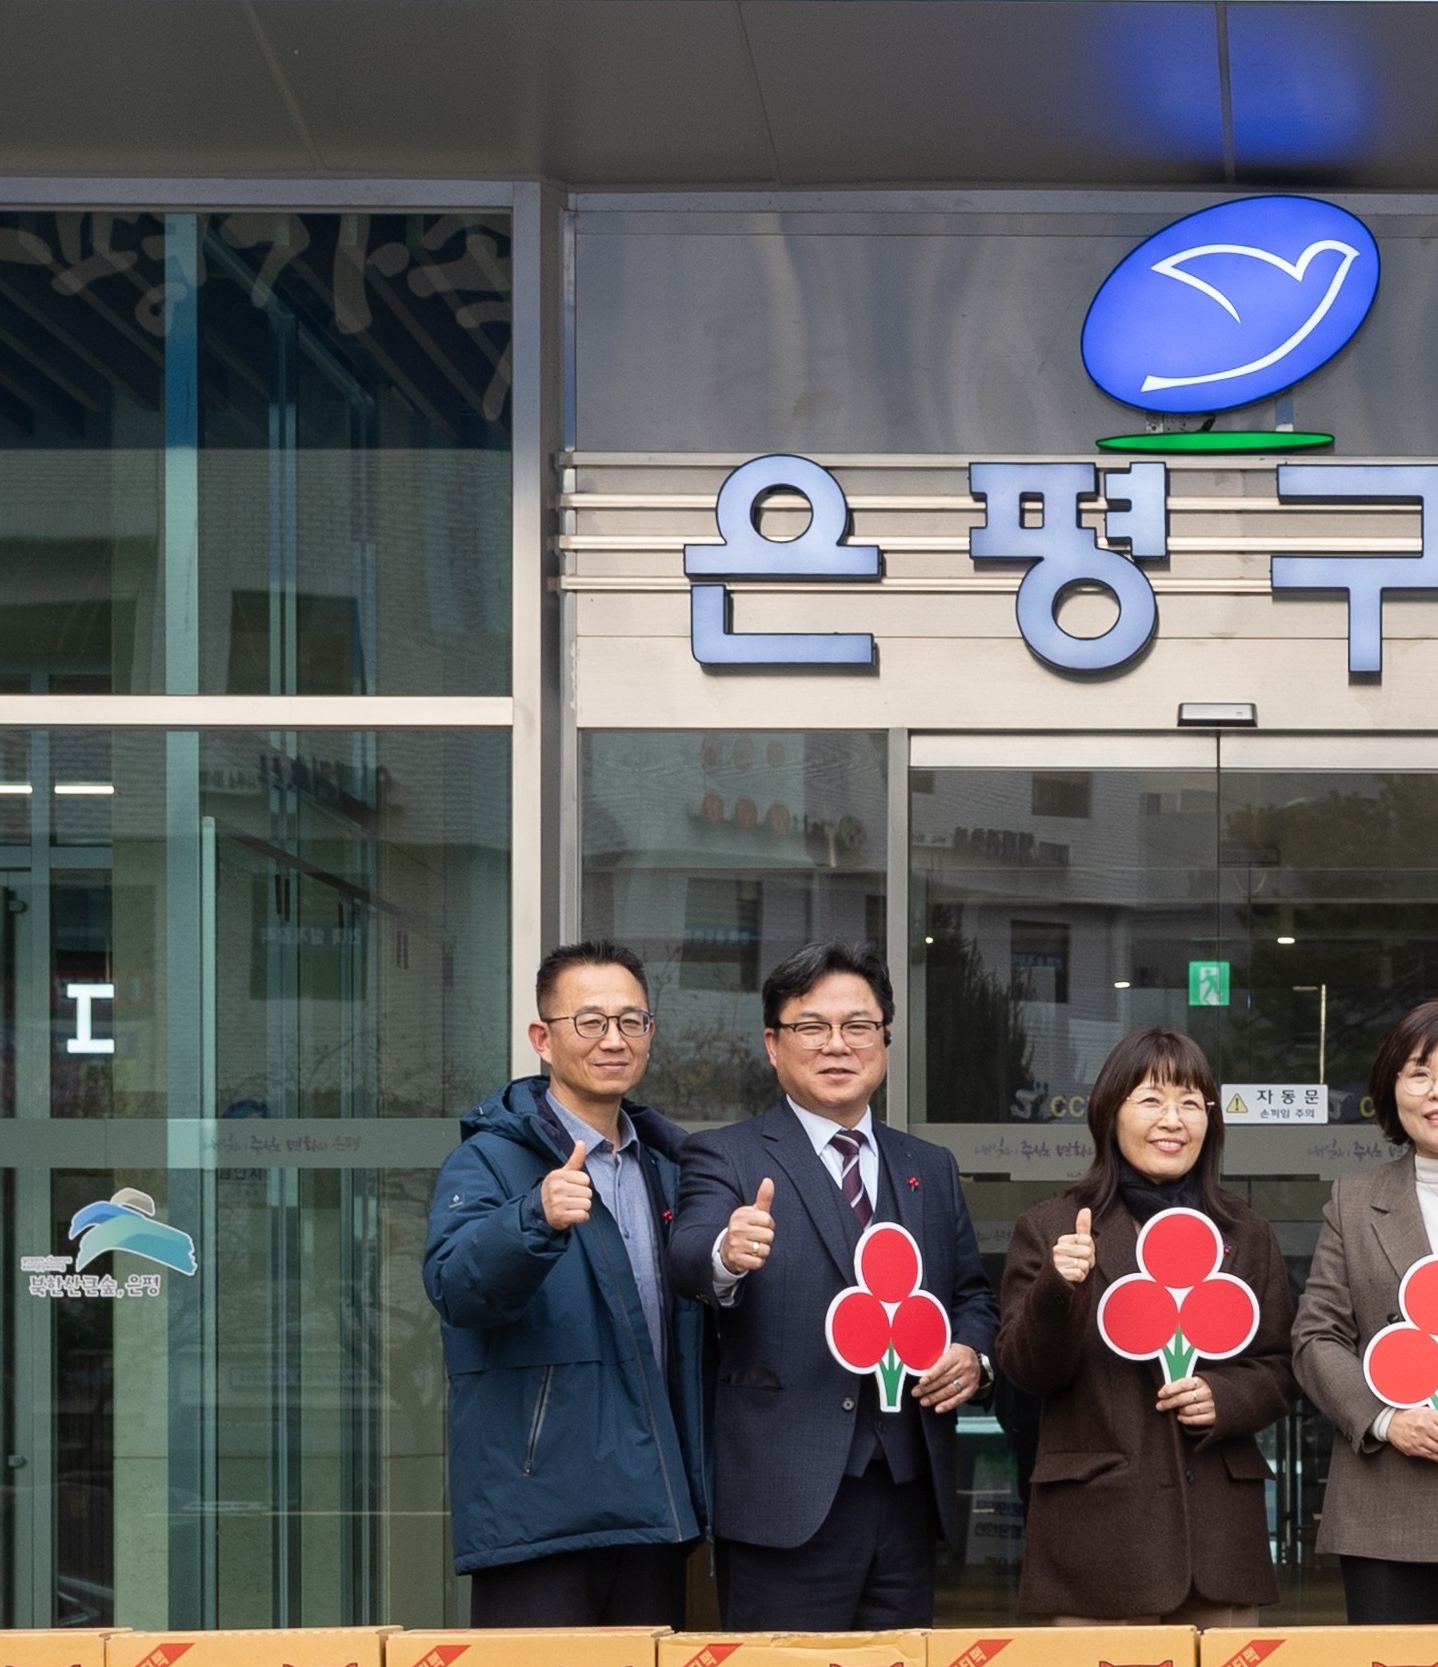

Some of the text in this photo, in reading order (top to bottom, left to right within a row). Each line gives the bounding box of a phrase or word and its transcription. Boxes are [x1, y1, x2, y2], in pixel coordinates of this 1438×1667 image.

[1256, 1088, 1320, 1105] 자동문
[1260, 1108, 1315, 1119] 손끼임 주의
[29, 1275, 161, 1298] 북한산큰숲, 은평
